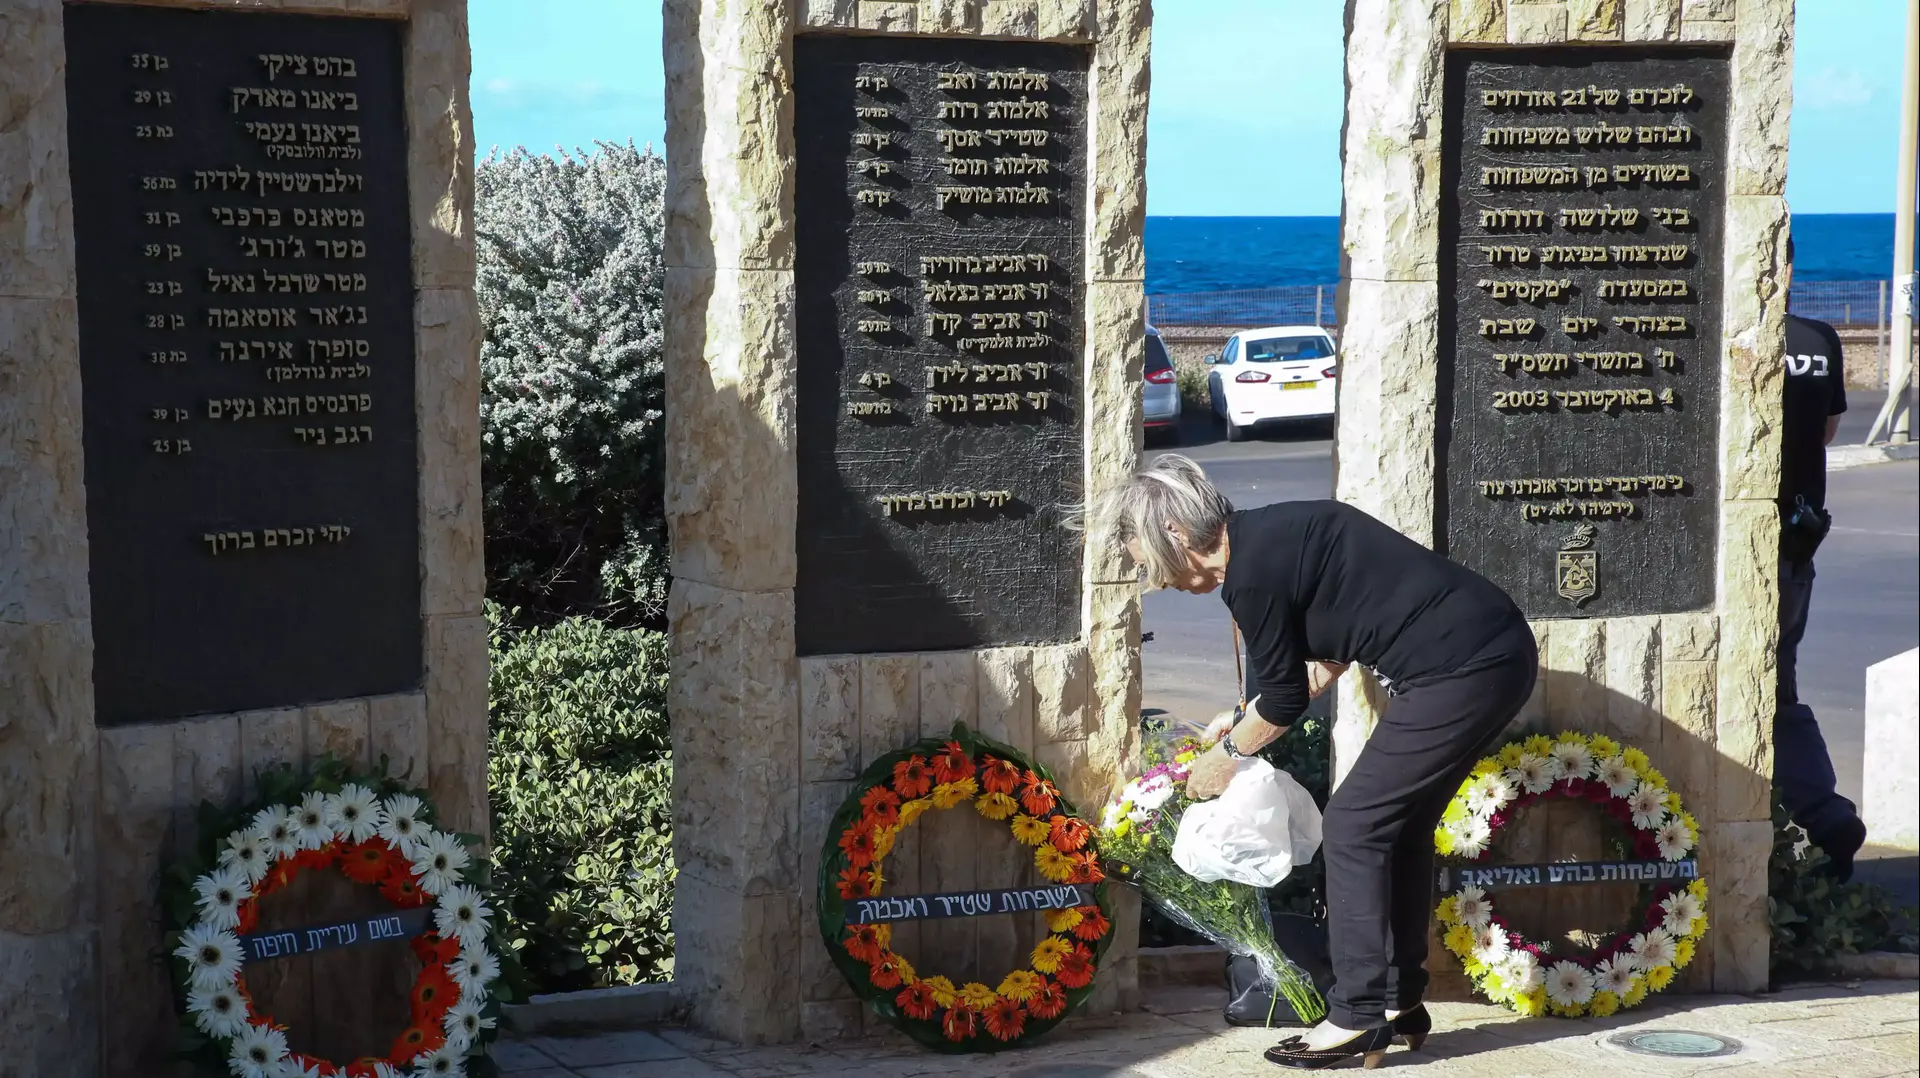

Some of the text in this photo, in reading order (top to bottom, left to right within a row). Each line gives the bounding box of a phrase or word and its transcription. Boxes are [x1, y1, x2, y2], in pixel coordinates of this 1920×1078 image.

[132, 54, 357, 81] בהט ציקי בן 35
[937, 72, 977, 90] זאב
[986, 68, 1049, 91] אלמוג
[134, 87, 358, 113] ביאנו מארק בן 29
[1561, 88, 1587, 106] 21
[1589, 84, 1620, 105] של
[1628, 84, 1693, 105] לזכרם
[937, 101, 979, 119] רות
[987, 95, 1049, 119] אלמוג
[136, 123, 361, 143] ביאנו נעמי בת 25
[936, 129, 981, 153] אסף
[985, 129, 1049, 146] שטייר
[1481, 121, 1692, 145] ובהם שלוש משפחות
[941, 157, 988, 175] תומר
[995, 153, 1049, 175] אלמוג
[194, 164, 250, 191] לידיה
[1481, 164, 1690, 187] בשתיים מן המשפחות
[936, 186, 993, 211] מושיק
[995, 181, 1050, 204] אלמוג
[145, 212, 161, 224] 31
[165, 211, 181, 227] בן
[1480, 203, 1689, 228] בני שלושה דורות
[144, 244, 161, 257] 59
[167, 244, 182, 261] בן
[315, 239, 366, 258] מטר
[1481, 244, 1688, 263] שנרצחו בפיגוע טרור
[983, 255, 1026, 273] אביב
[1027, 254, 1049, 272] זר
[147, 267, 367, 296] מטר שרבל נאיל בן 23
[1597, 279, 1688, 297] במסעדת
[983, 283, 1026, 301] אביב
[1029, 283, 1049, 300] זר
[148, 316, 165, 328] 28
[170, 314, 185, 330] בן
[208, 307, 297, 327] אוסאמה
[924, 313, 962, 337] קרן
[972, 312, 1020, 330] אביב
[1027, 311, 1049, 328] זר
[1478, 316, 1687, 335] בצהרי יום שבת
[151, 352, 166, 363] 38
[169, 350, 187, 362] בת
[220, 340, 293, 361] אירנה
[1573, 351, 1643, 370] בתשרי
[973, 363, 1023, 382] אביב
[1026, 362, 1049, 380] זר
[152, 393, 372, 422] פרנסיס חנא נעים בן 39
[972, 392, 1020, 411] אביב
[1027, 392, 1049, 410] זר
[1493, 388, 1673, 411] 4 באוקטובר 2003
[294, 427, 326, 445] ניר
[334, 425, 373, 443] רגב
[176, 439, 191, 455] בן
[1480, 475, 1684, 496] כי מדי דברי בו זכר אזכרנו עוד
[880, 490, 1012, 517] יהי זכרם ברוך
[204, 525, 350, 555] יהי זכרם ברוך
[1548, 865, 1595, 883] בהט
[857, 885, 1081, 924] משפחות שטייר ואלמוג
[252, 916, 404, 958] בשם עיריית חיפה
